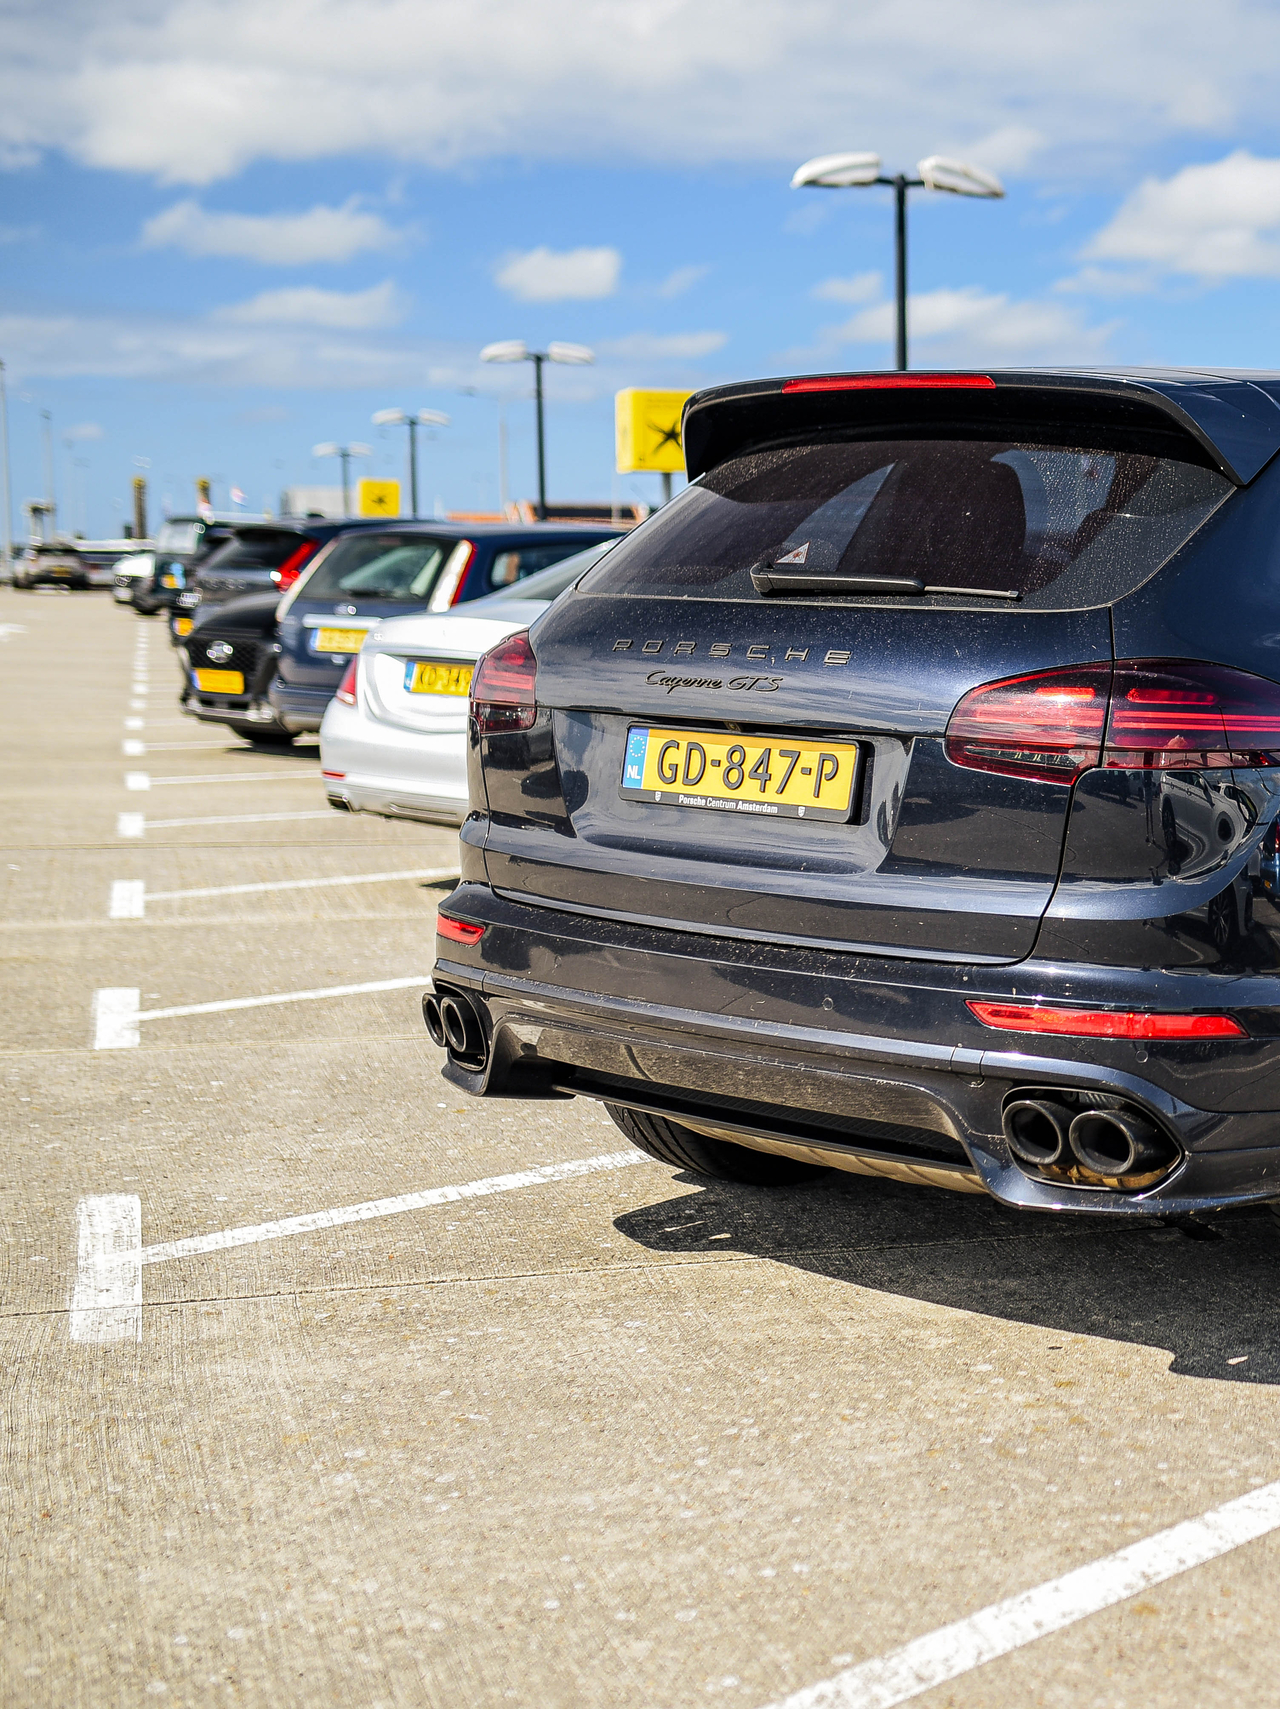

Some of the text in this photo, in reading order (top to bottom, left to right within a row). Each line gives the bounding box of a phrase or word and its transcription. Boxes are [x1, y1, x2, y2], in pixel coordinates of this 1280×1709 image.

[612, 639, 852, 665] PORSCHE
[645, 670, 784, 694] Cayenne GTS
[626, 764, 642, 780] NL
[657, 739, 839, 798] GD-847-P
[678, 794, 779, 814] Porsche Centrum Amsterdam
